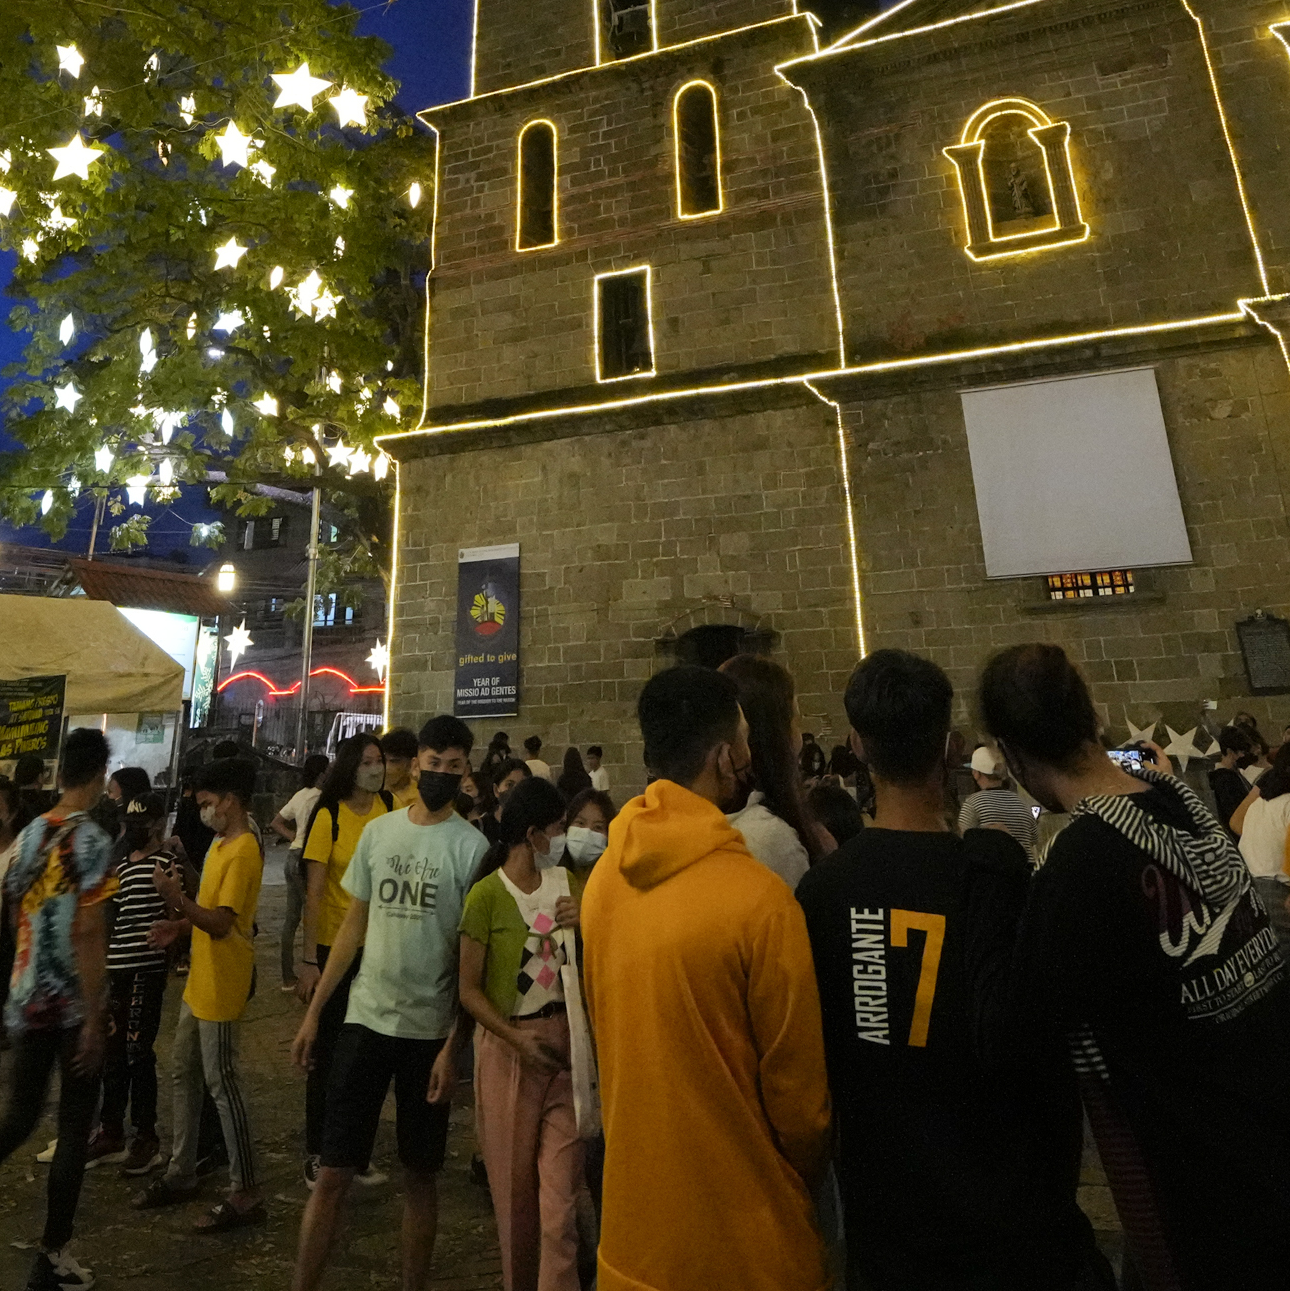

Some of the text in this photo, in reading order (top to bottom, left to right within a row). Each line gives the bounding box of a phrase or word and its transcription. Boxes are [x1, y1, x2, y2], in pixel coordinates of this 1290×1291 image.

[458, 651, 517, 667] gifted to give
[456, 685, 517, 698] MISSIO AD GENTES
[473, 676, 500, 687] YEAR OF
[379, 878, 439, 909] ONE
[850, 907, 890, 1046] ARROGANTE
[890, 908, 946, 1047] 7
[1180, 975, 1215, 1004] ALL
[1213, 956, 1240, 992] DAY
